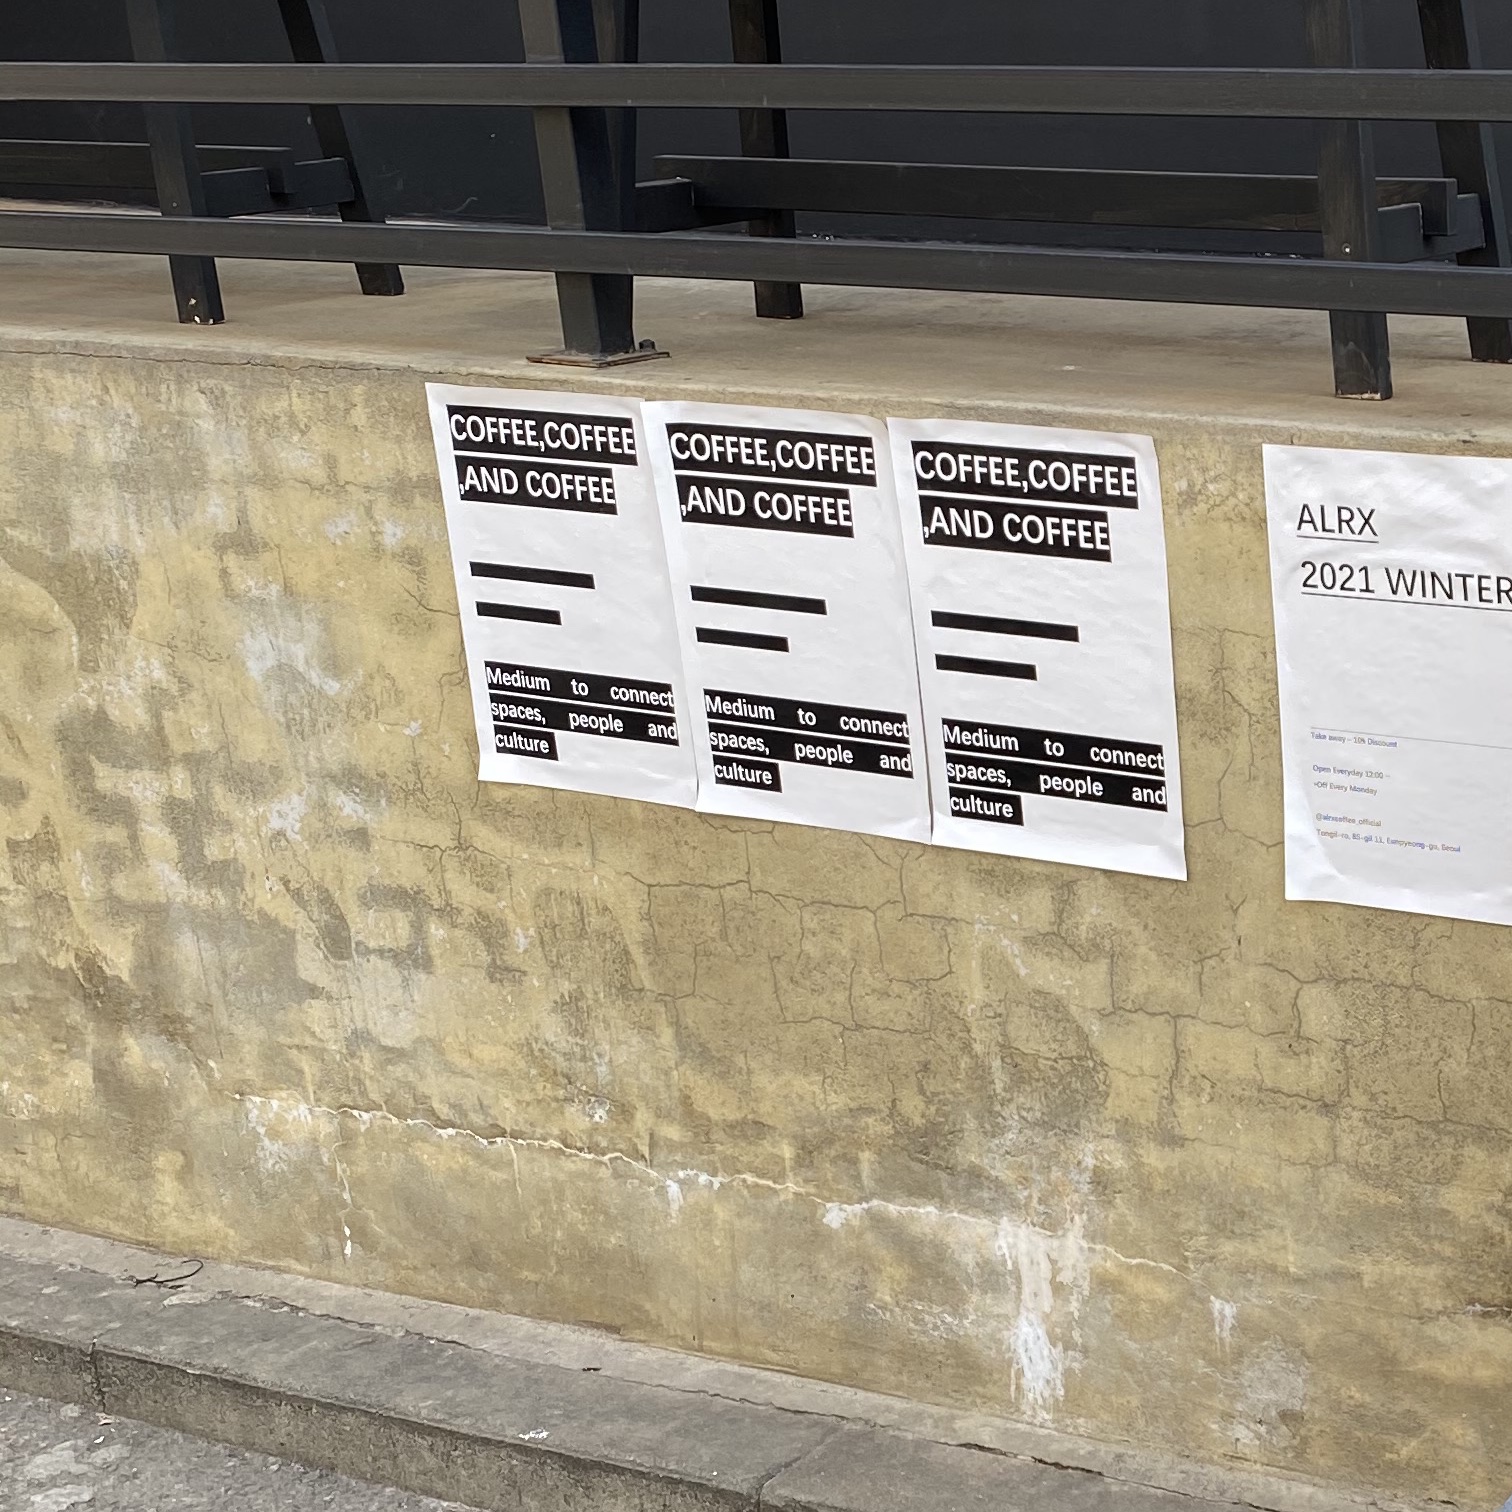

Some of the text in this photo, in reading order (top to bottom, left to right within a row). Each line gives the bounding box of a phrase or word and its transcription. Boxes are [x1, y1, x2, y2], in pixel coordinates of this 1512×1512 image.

[450, 413, 637, 455] COFFEE,COFFEE
[670, 432, 876, 475] COFFEE,COFFEE
[525, 470, 616, 504] COFFEE
[914, 450, 1138, 497] COFFEE,COFFEE
[753, 491, 853, 527] COFFEE
[1297, 503, 1379, 537] ALRX
[1002, 512, 1112, 550] COFFEE
[1301, 560, 1376, 594] 2021
[485, 666, 676, 708] Medium to connect
[490, 702, 678, 741] spaces, people and
[705, 694, 910, 739] Medium to connect
[495, 731, 550, 754] culture
[709, 730, 913, 772] spaces, people and
[942, 724, 1165, 771] Medium to connect
[1367, 738, 1398, 748] Discount
[714, 762, 773, 785] culture
[946, 762, 1167, 805] spaces, people and
[1312, 764, 1331, 774] Open
[1333, 766, 1364, 779] Everyday
[1329, 782, 1348, 793] Every
[1349, 784, 1378, 796] Monday
[950, 795, 1014, 818] culture
